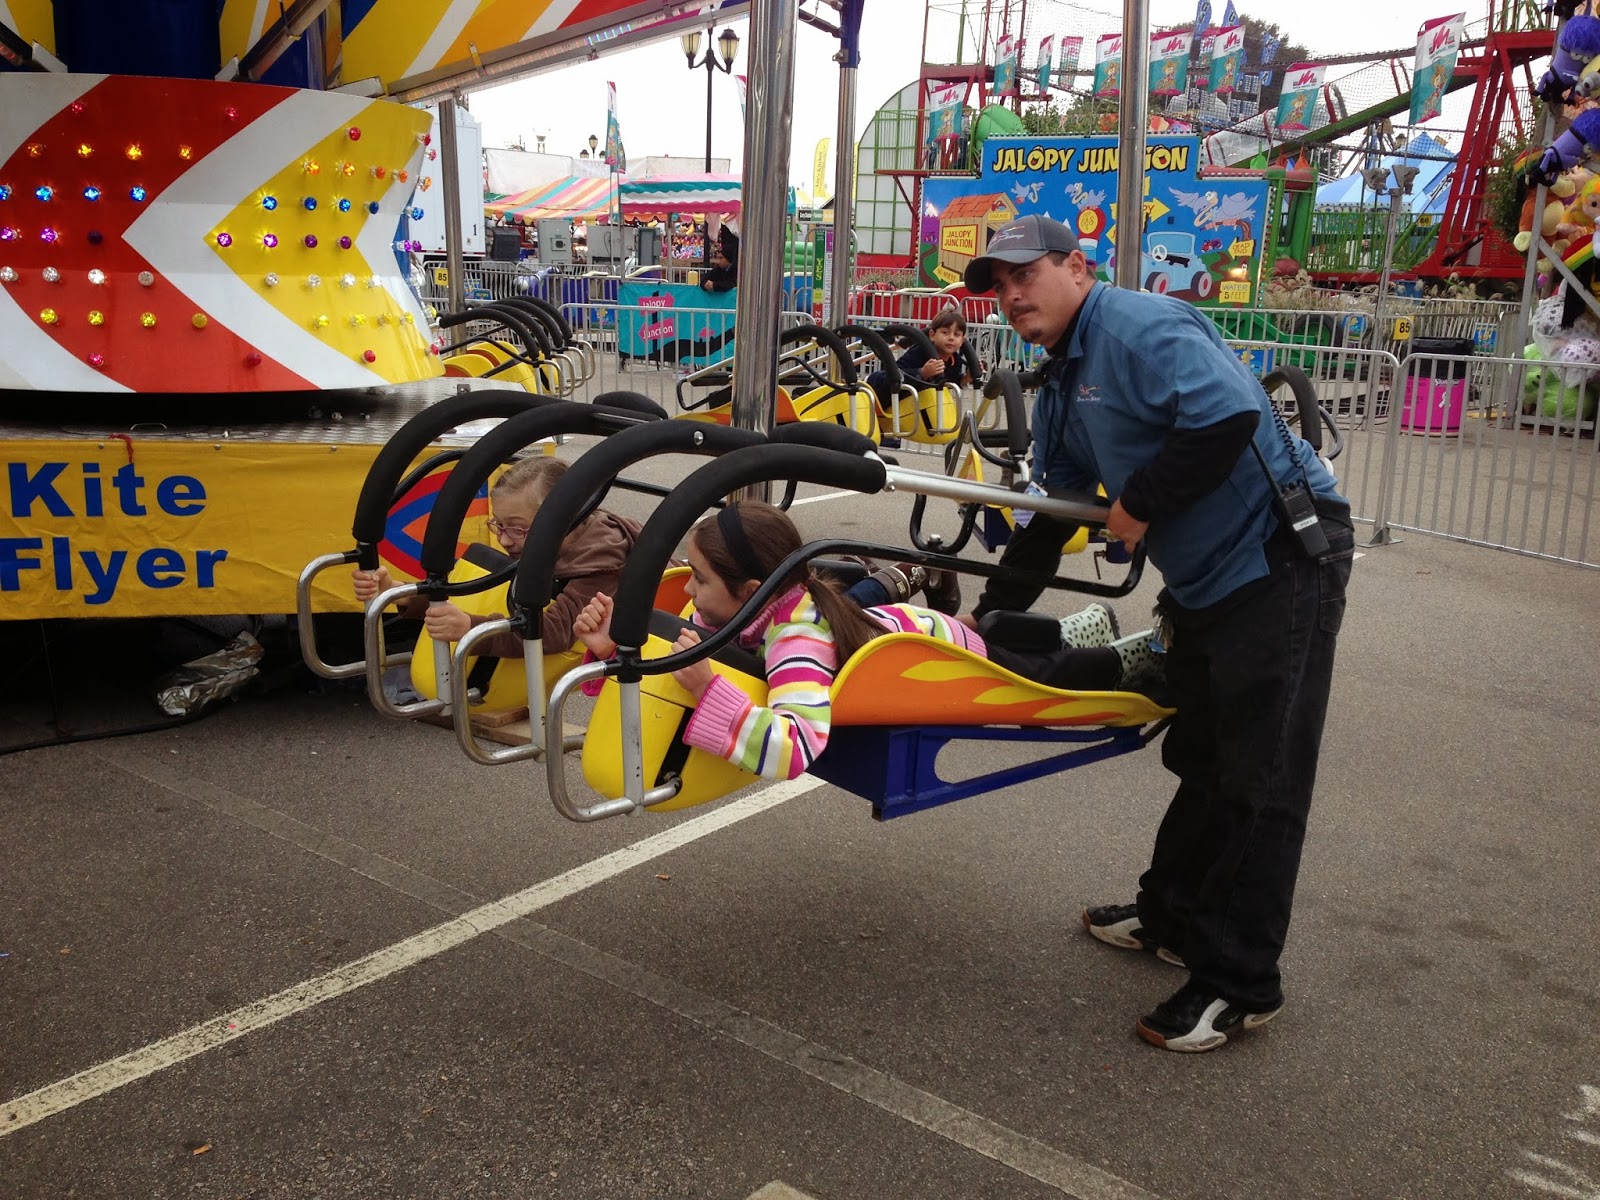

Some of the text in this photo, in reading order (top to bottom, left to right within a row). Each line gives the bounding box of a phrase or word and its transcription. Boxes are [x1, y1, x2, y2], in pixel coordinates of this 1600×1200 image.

[993, 144, 1189, 173] JALOPY JUNION
[947, 230, 972, 239] JALOPY
[944, 239, 973, 249] JUNCTION
[815, 257, 823, 281] YES
[437, 272, 448, 282] 85
[1222, 284, 1248, 292] WATER
[1224, 292, 1247, 300] 5 FEET
[643, 325, 673, 339] Juncton
[1399, 321, 1411, 334] 85
[8, 462, 207, 517] Kite
[0, 536, 228, 605] Flyer
